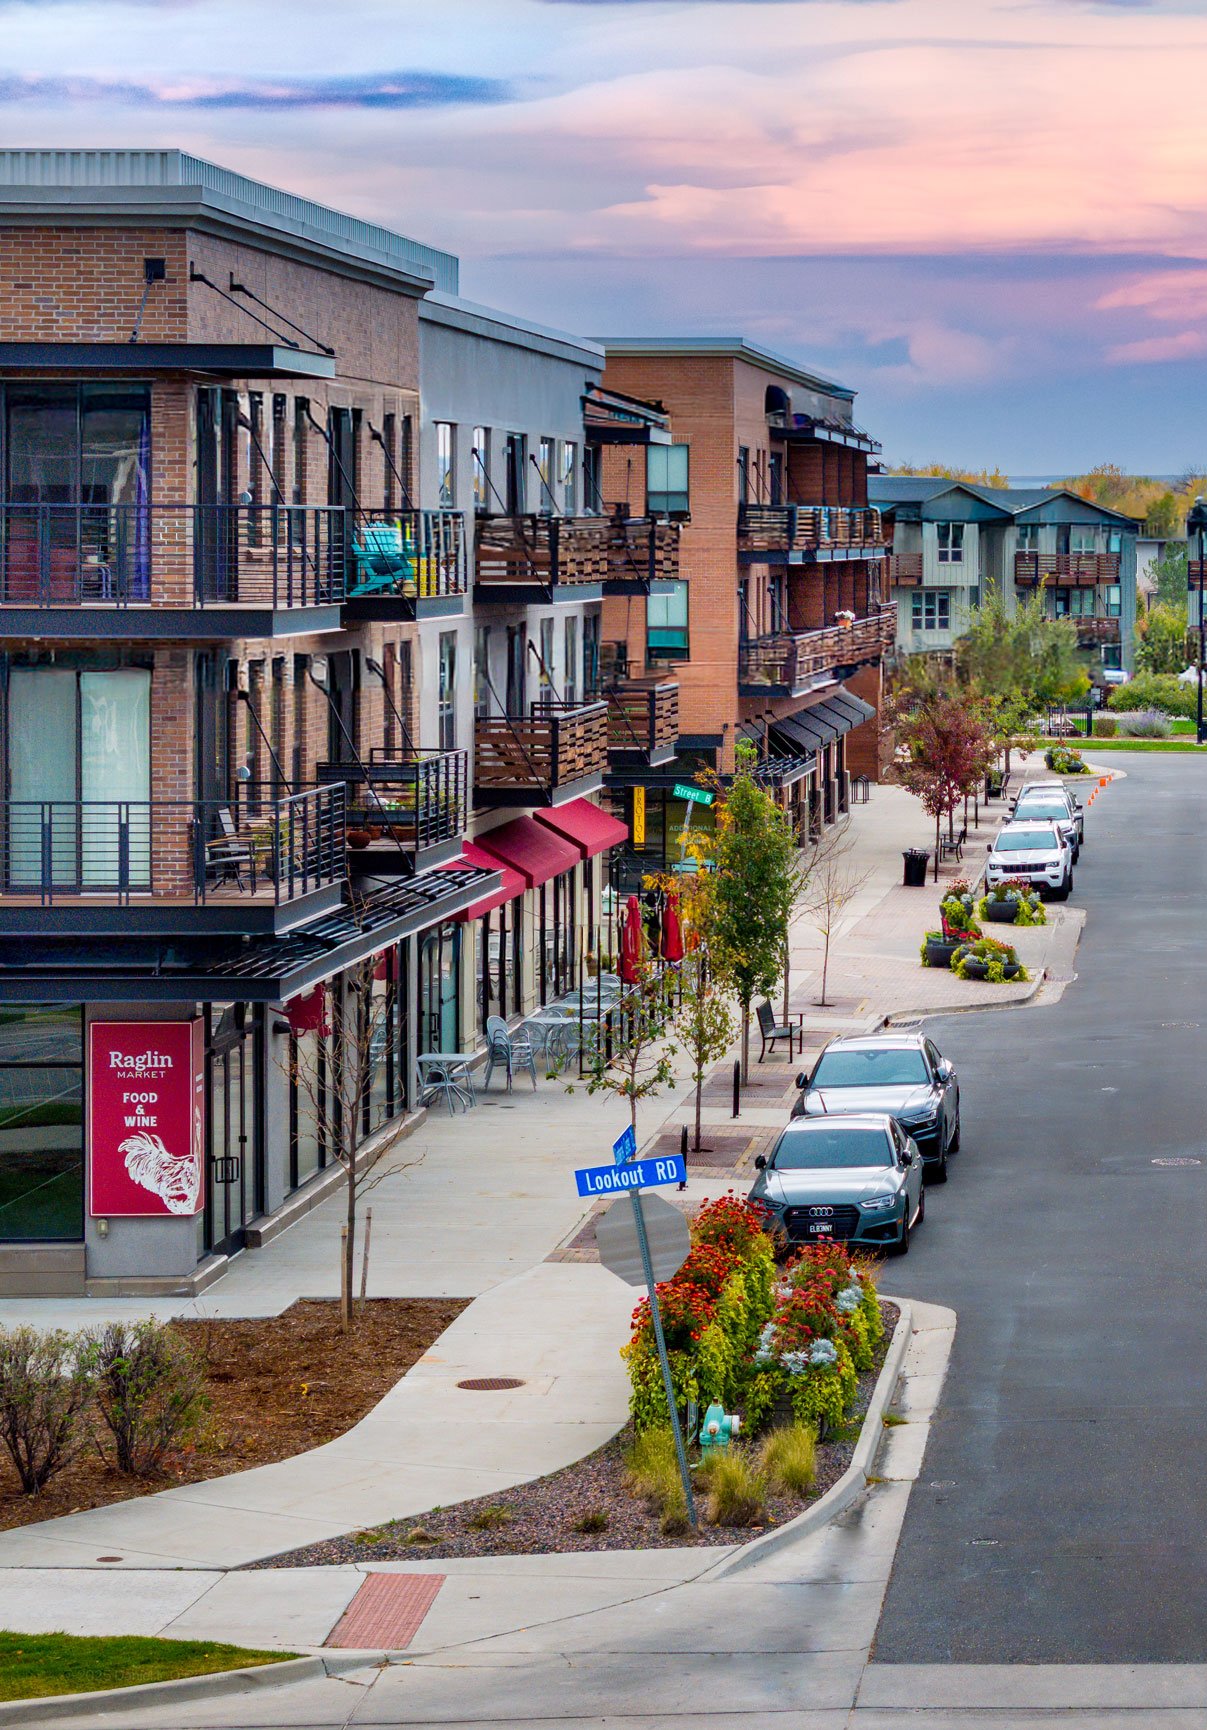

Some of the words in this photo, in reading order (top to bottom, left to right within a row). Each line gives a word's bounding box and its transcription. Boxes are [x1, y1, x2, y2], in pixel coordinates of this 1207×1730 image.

[674, 786, 700, 800] Street
[704, 794, 713, 803] B
[635, 787, 643, 841] PROTOS
[109, 1051, 173, 1071] Raglin
[123, 1092, 158, 1103] FOOD
[135, 1104, 145, 1115] &
[124, 1116, 158, 1127] WINE
[585, 1165, 645, 1192] Lookout
[655, 1160, 678, 1181] RD
